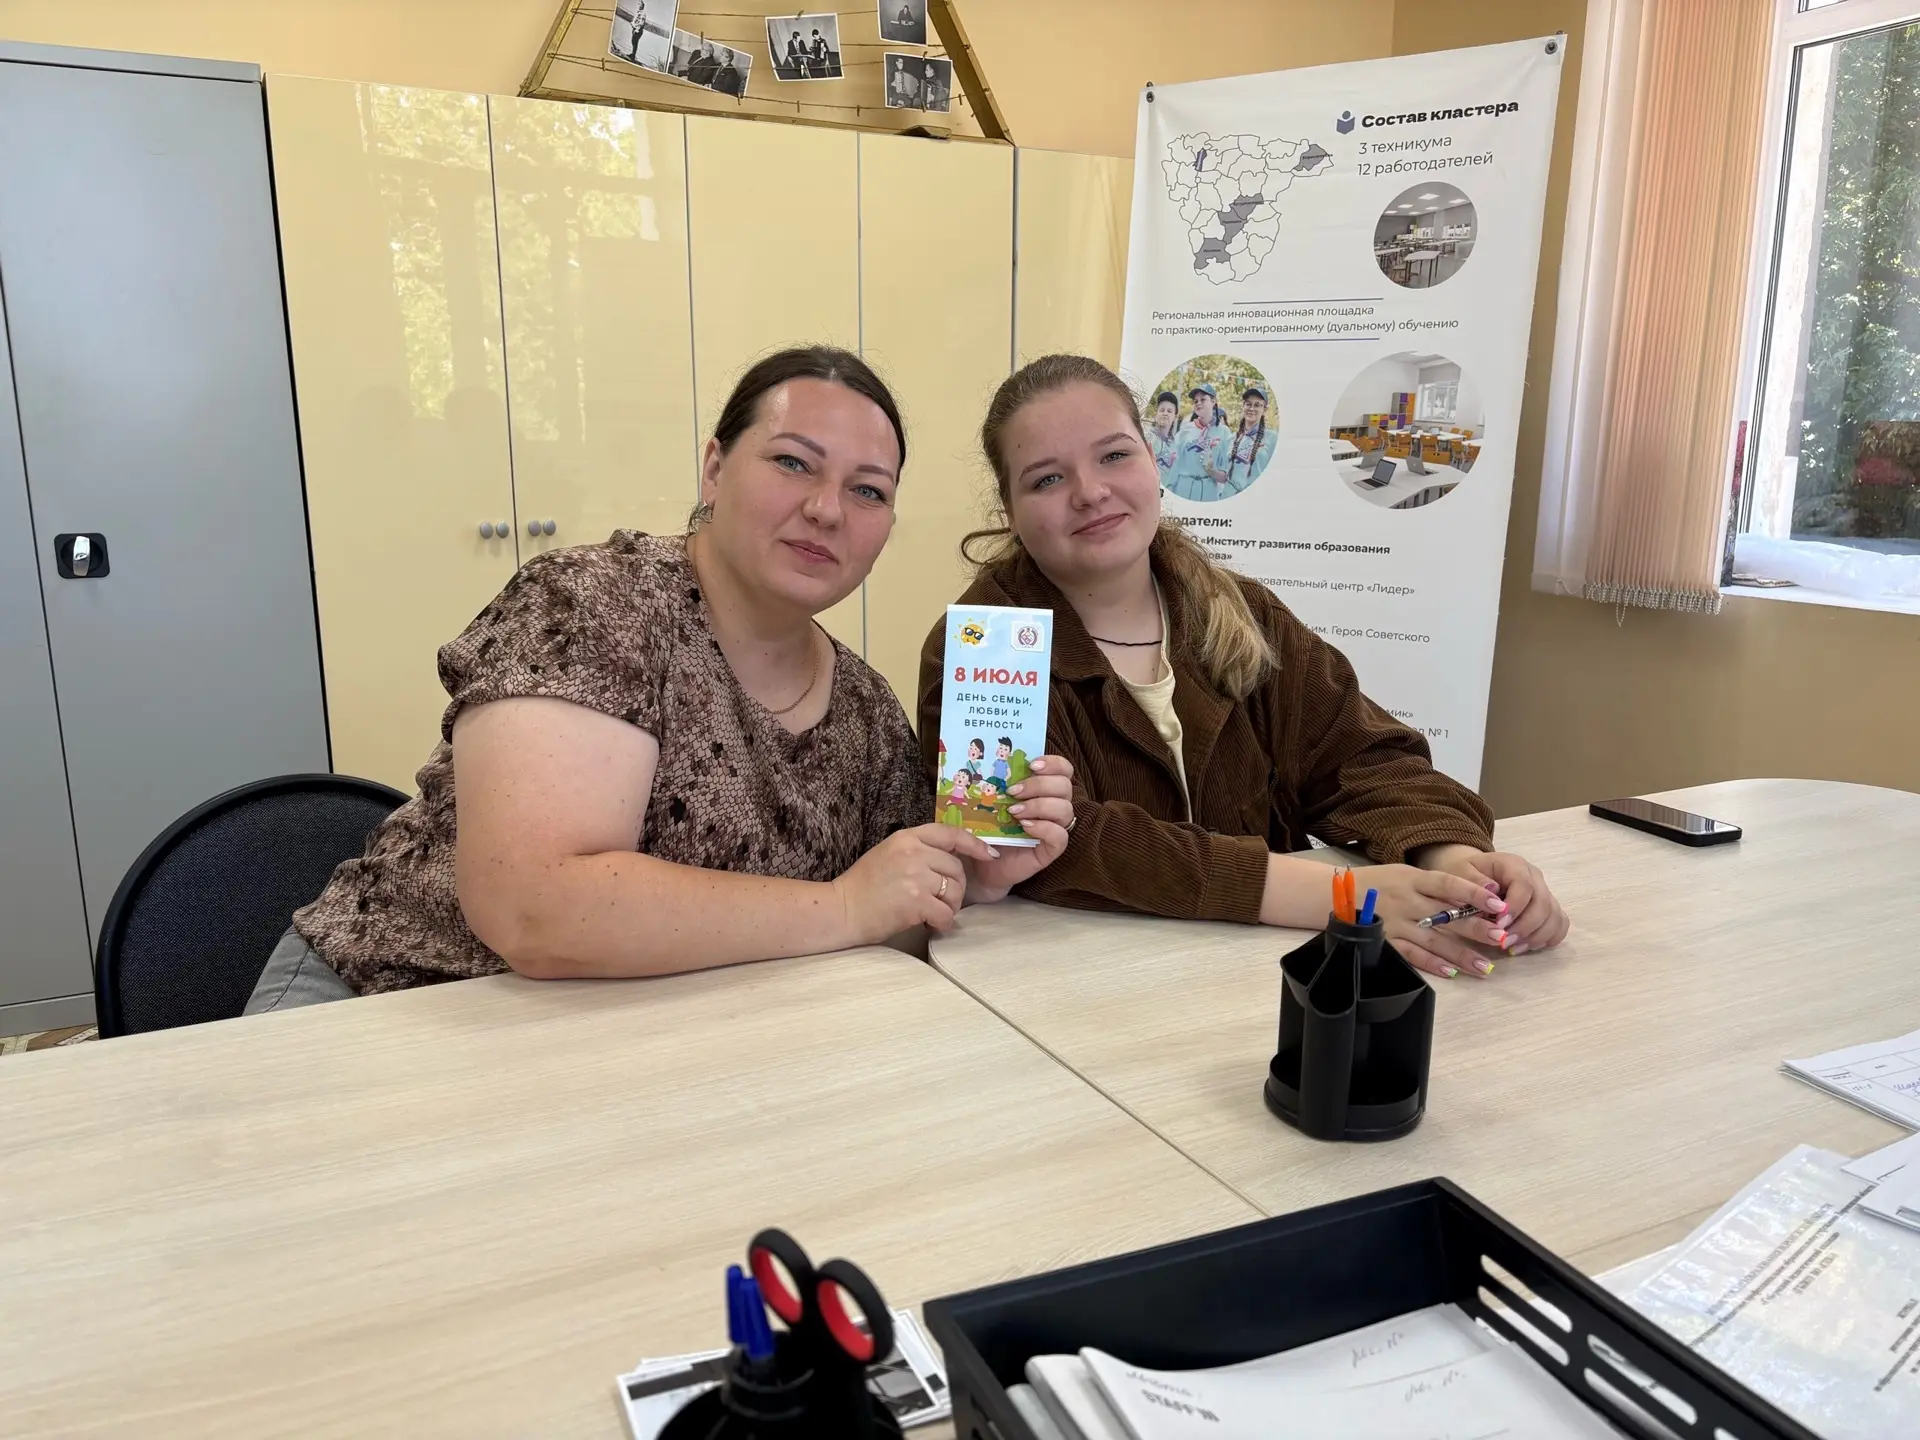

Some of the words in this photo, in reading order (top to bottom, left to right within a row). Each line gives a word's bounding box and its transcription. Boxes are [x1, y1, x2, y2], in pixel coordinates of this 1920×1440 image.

[1361, 112, 1427, 128] Состав
[1430, 101, 1519, 121] кластера
[1358, 142, 1368, 155] 3
[1371, 136, 1452, 154] техникума
[1357, 163, 1371, 176] 12
[1374, 151, 1493, 177] работодателей
[1152, 311, 1225, 320] Региональная
[1227, 307, 1314, 319] инновационная
[1316, 306, 1374, 317] площадка
[1150, 326, 1164, 335] по
[1165, 321, 1325, 336] практико-ориентированному
[1327, 319, 1396, 334] (дуальному)
[1399, 318, 1459, 331] обучению
[1200, 536, 1257, 548] «Институт
[1258, 539, 1311, 550] развития
[1314, 541, 1391, 555] образования
[1330, 581, 1364, 593] центр
[1366, 583, 1415, 596] «Лидер»
[1331, 625, 1363, 637] Героя
[1365, 628, 1430, 643] Советского
[954, 667, 967, 682] 8
[973, 667, 1038, 687] ИЮЛЯ
[956, 692, 987, 702] ДЕНЬ
[991, 694, 1033, 706] СЕМЬИ,
[968, 706, 1008, 716] ЛЮБВИ
[1013, 709, 1020, 717] И
[964, 719, 1023, 730] ВЕРНОСТИ
